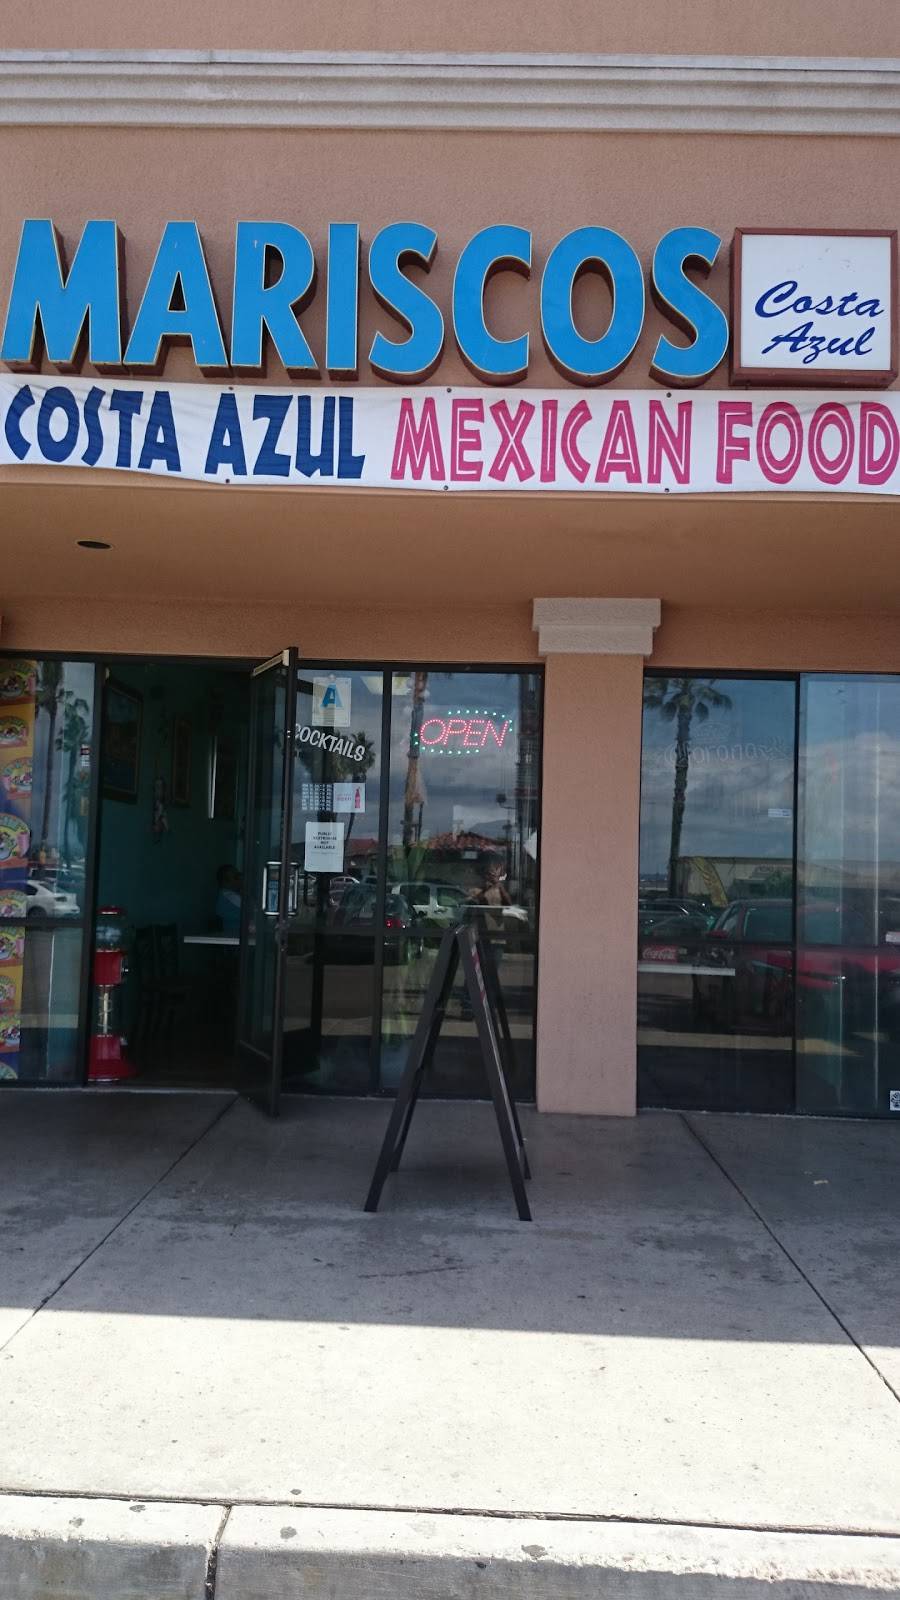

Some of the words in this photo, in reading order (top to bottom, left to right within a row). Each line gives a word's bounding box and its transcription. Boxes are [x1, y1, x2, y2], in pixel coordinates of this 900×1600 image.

[2, 219, 730, 379] MARISCOS
[755, 281, 884, 319] Costa
[762, 321, 876, 363] Azul
[5, 384, 181, 472] COSTA
[204, 392, 366, 479] AZUL
[392, 397, 692, 484] MEXICAN
[715, 401, 899, 485] FOOD
[320, 683, 344, 708] A
[420, 719, 509, 747] OPEN
